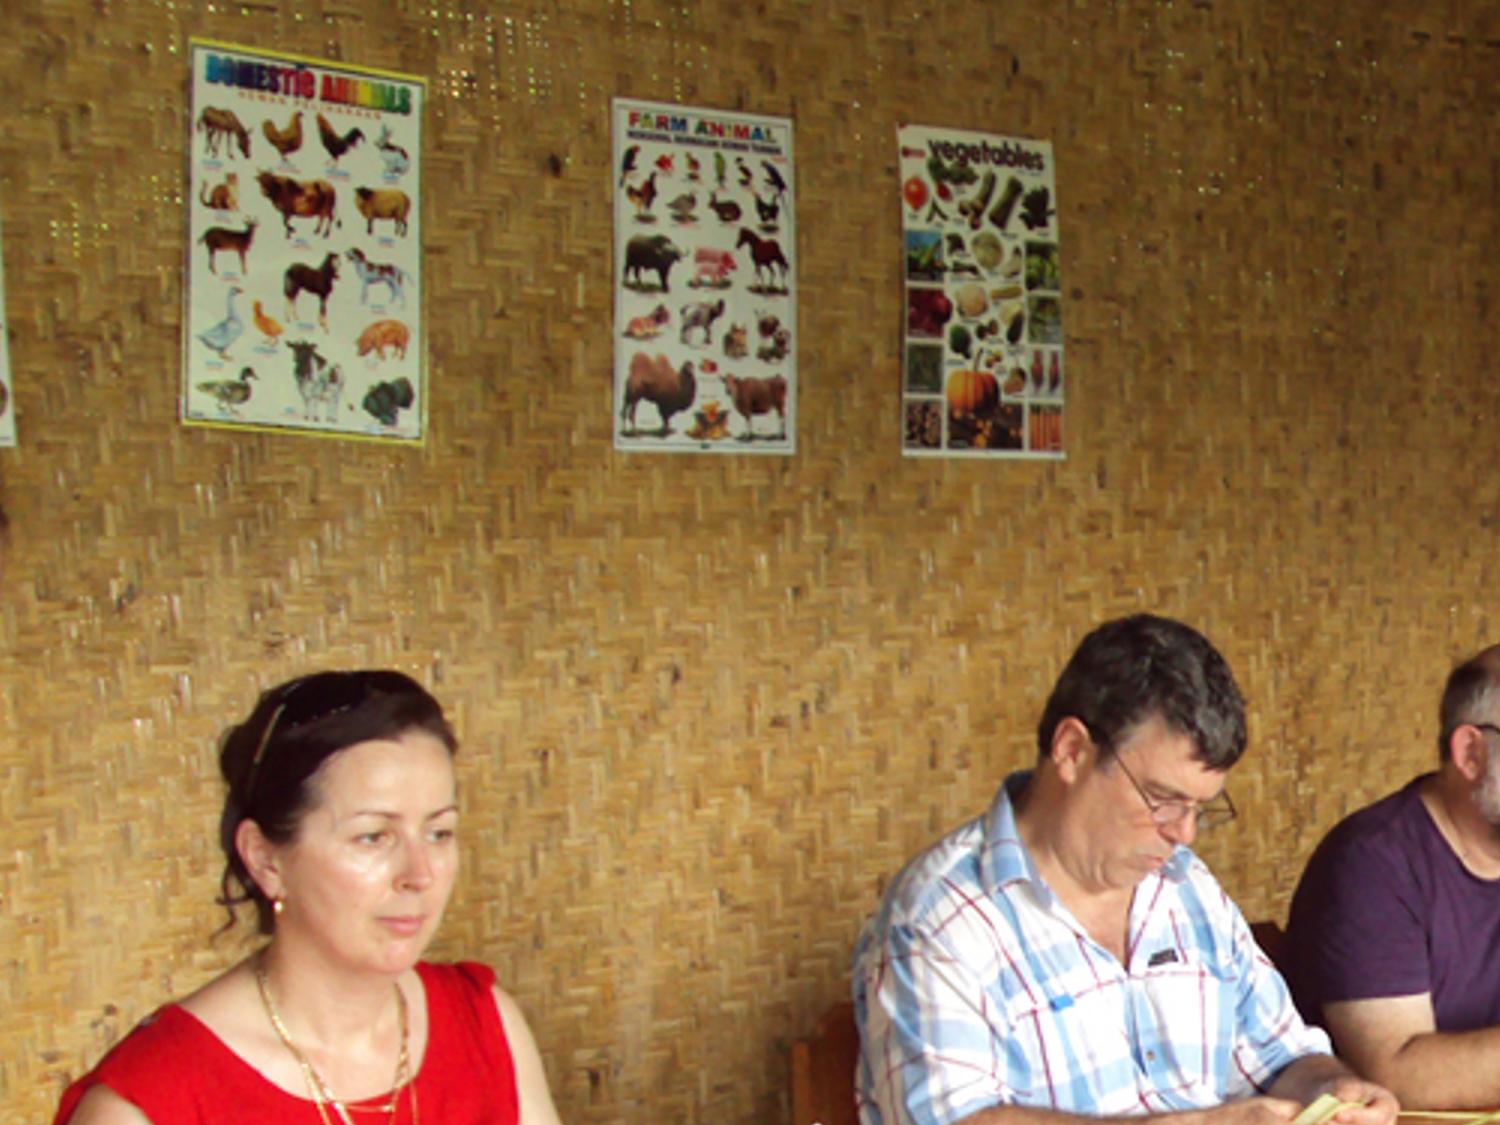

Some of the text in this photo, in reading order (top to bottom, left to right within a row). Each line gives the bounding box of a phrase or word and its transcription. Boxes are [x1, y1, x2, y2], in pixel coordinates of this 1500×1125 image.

[206, 53, 411, 115] DOMESTIC ANIMALS
[628, 111, 688, 132] FARM
[695, 120, 777, 143] ANIMAL
[928, 139, 1044, 171] vegetables
